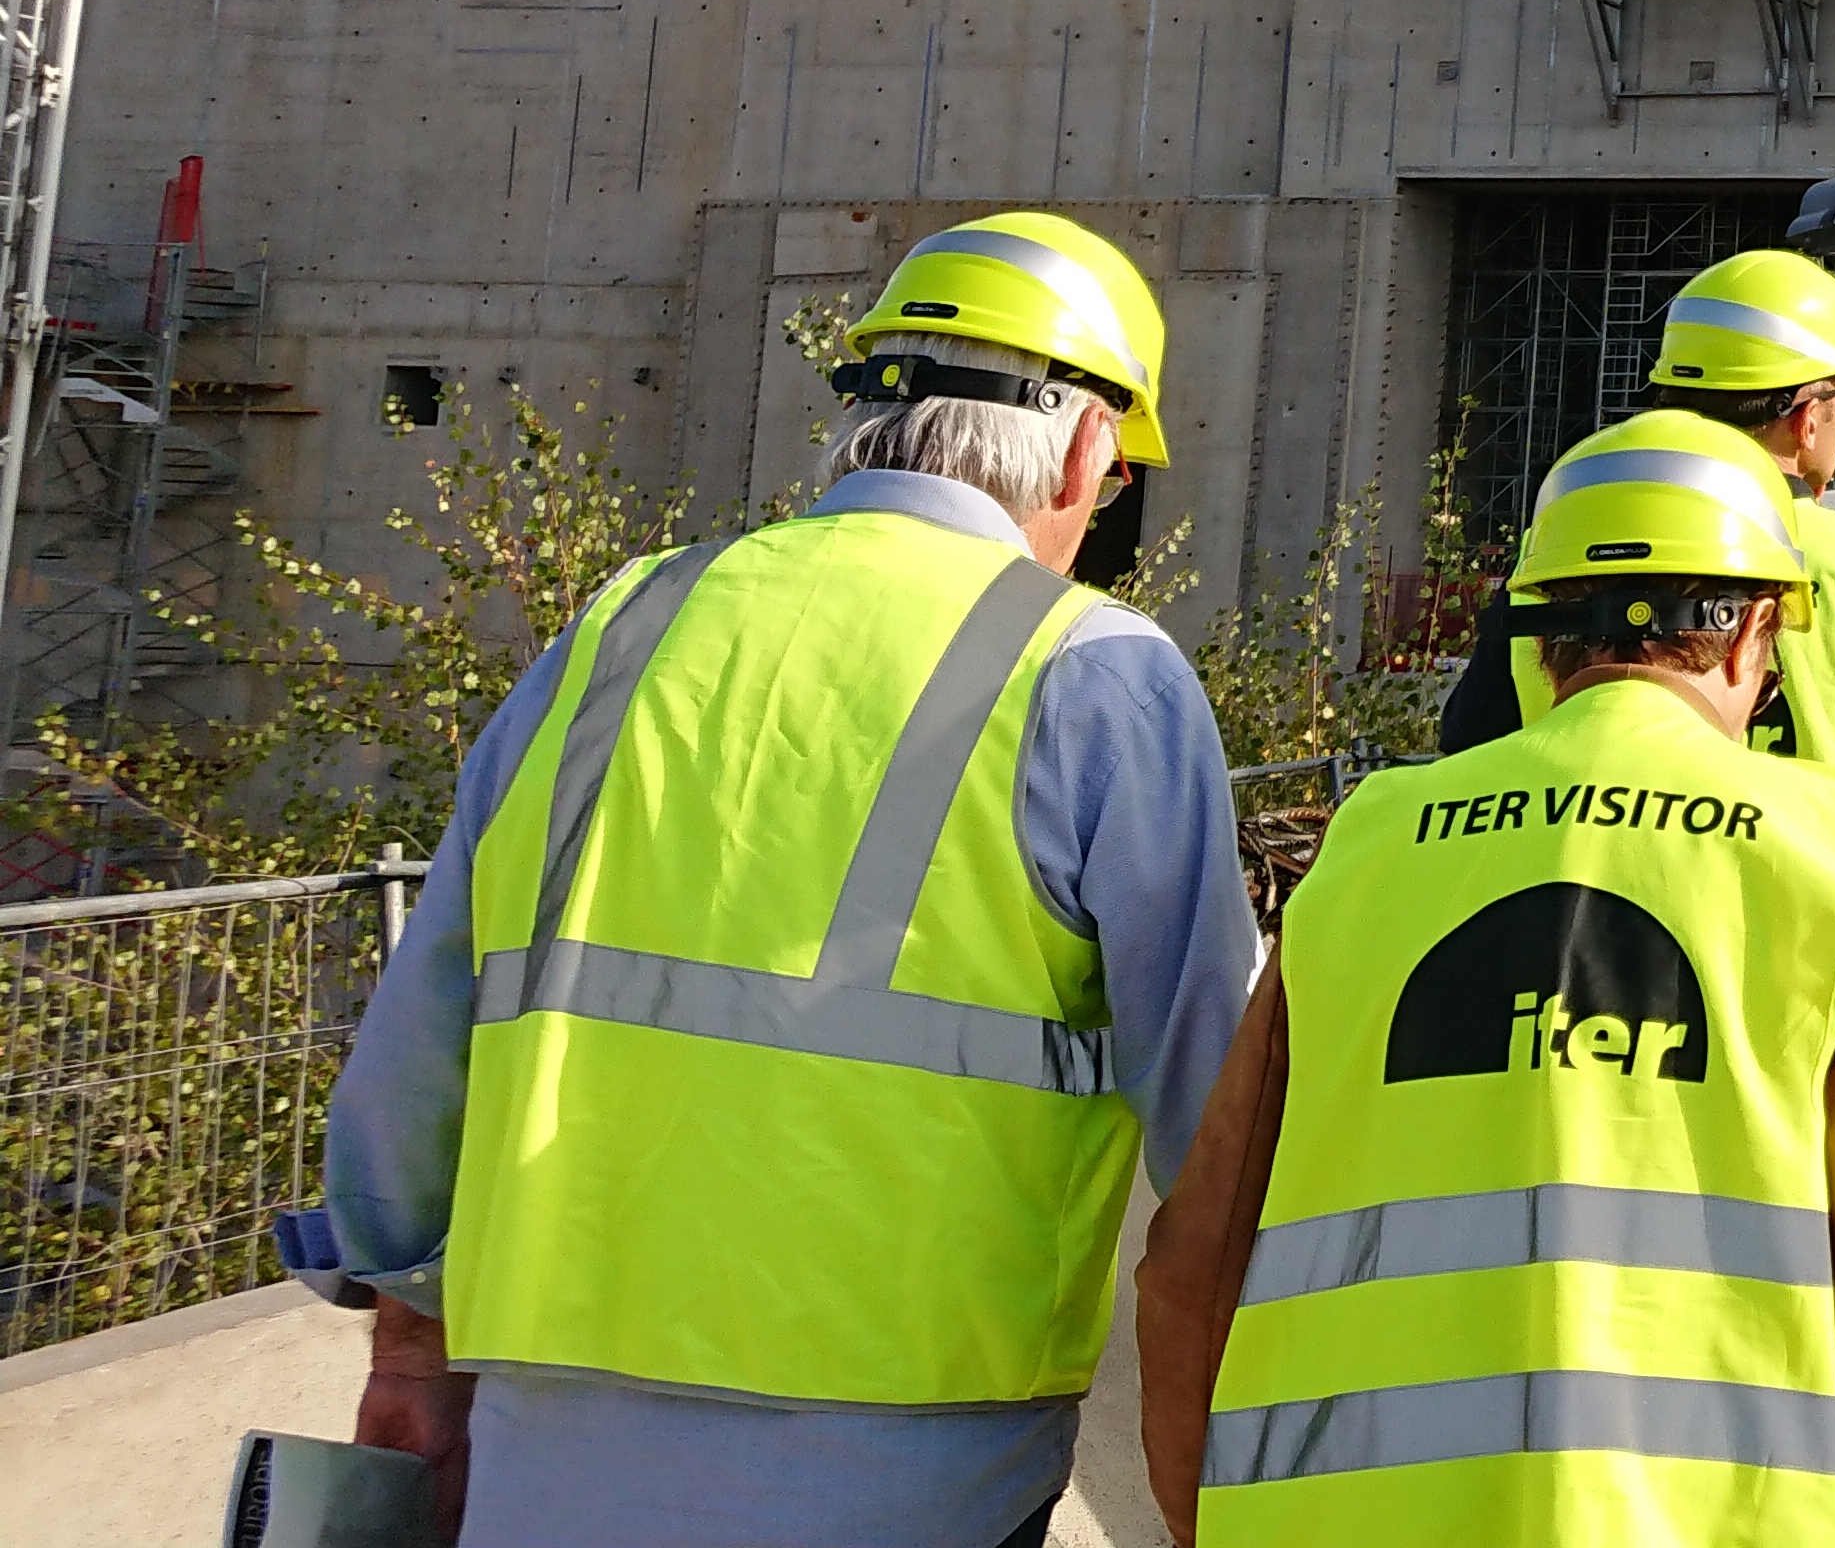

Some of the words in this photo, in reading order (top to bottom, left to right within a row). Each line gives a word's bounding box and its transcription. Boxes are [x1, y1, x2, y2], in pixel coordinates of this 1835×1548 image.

[1415, 790, 1530, 844] ITER
[1545, 784, 1763, 841] VISITOR
[1507, 991, 1688, 1080] iter
